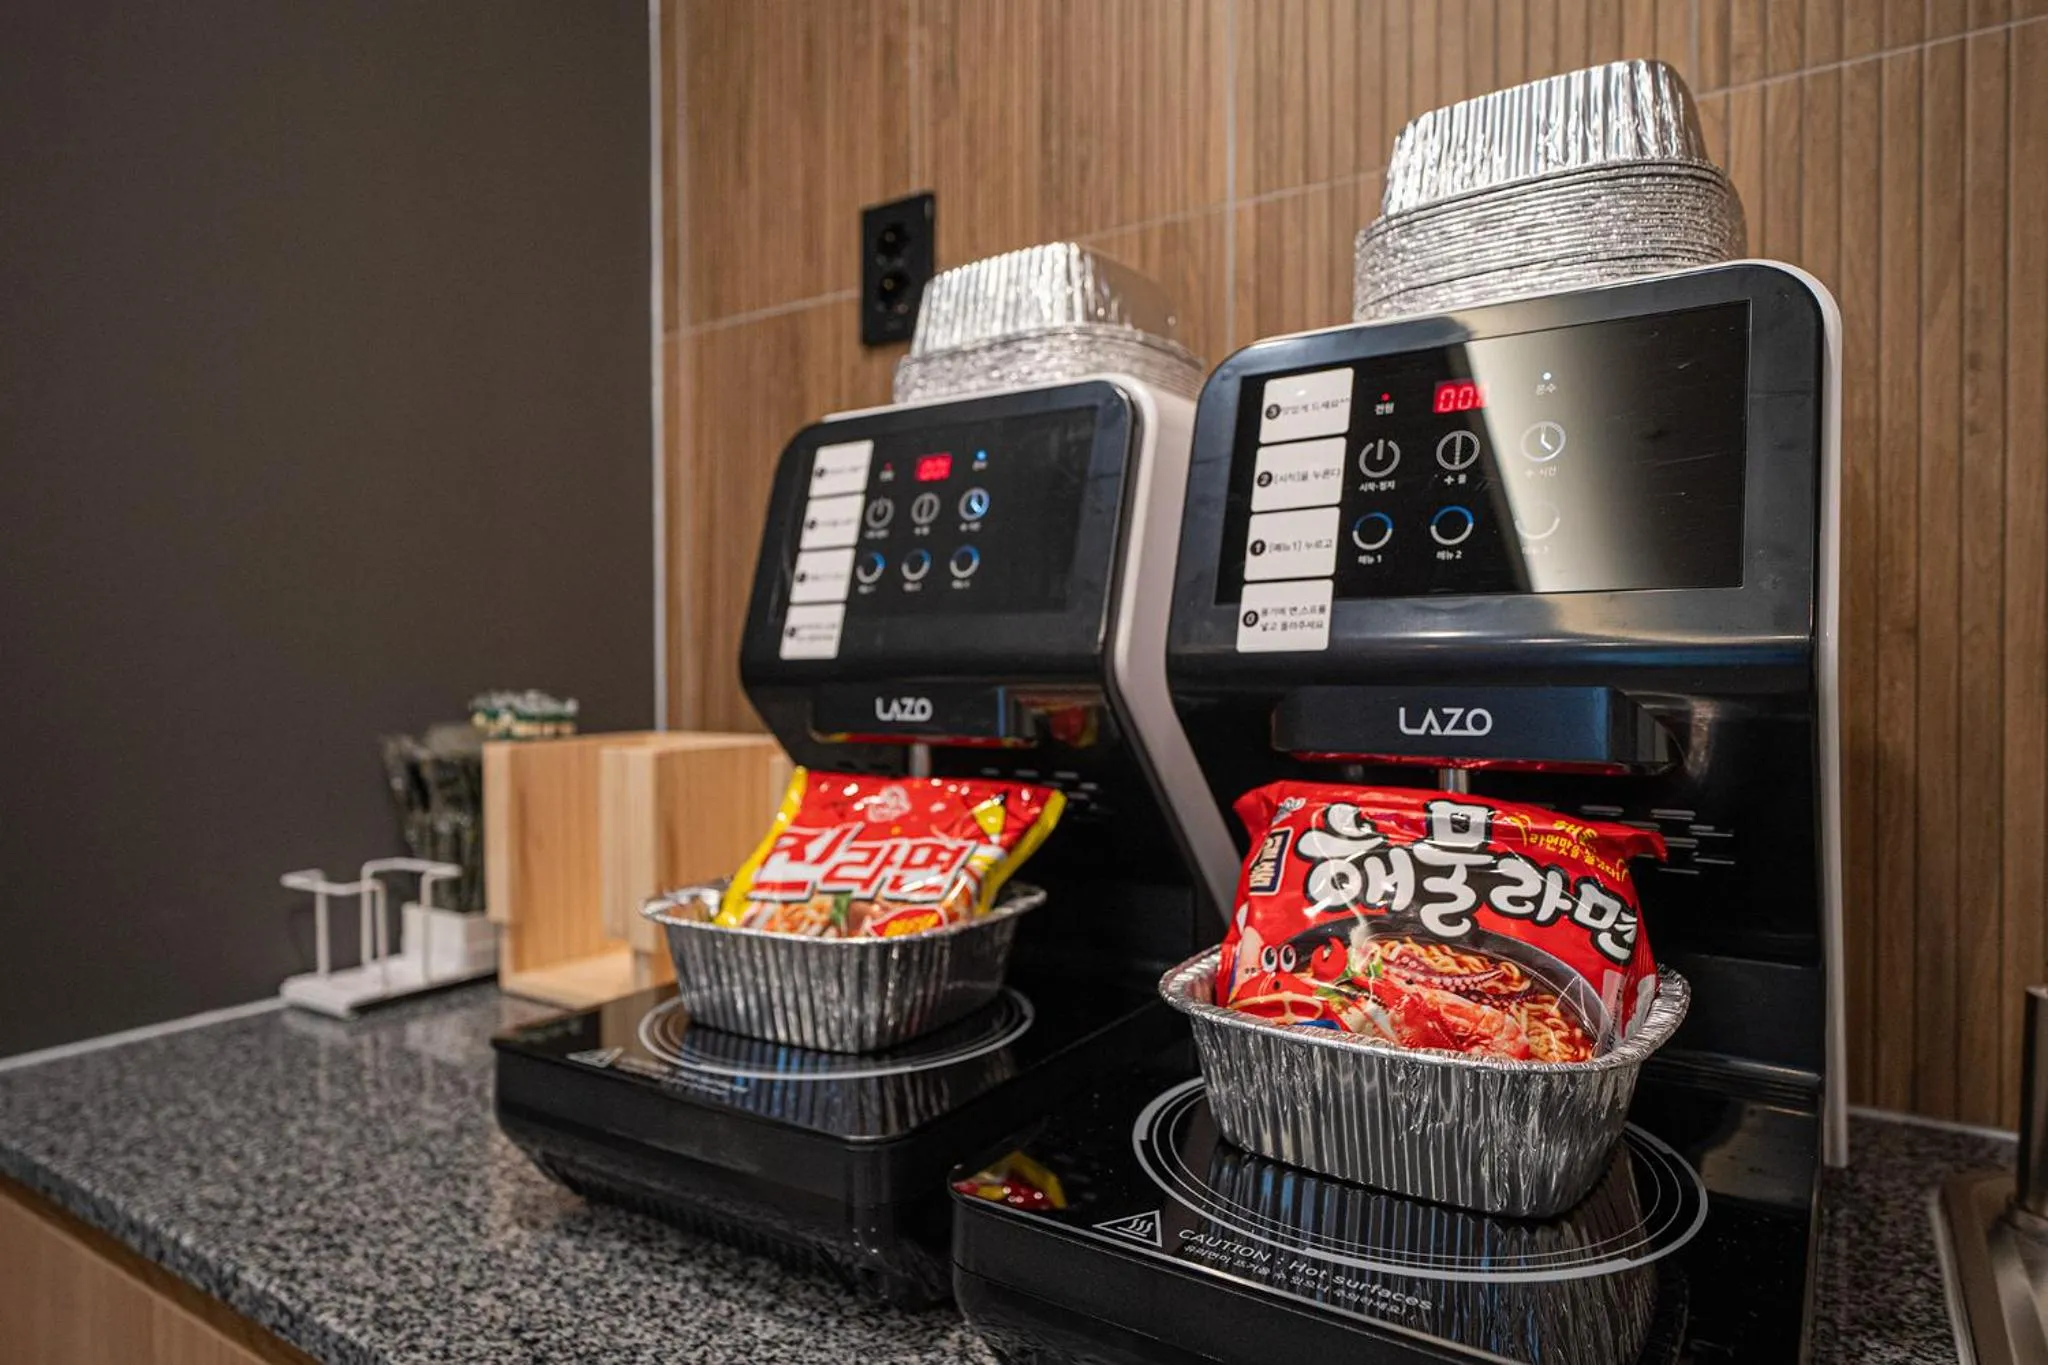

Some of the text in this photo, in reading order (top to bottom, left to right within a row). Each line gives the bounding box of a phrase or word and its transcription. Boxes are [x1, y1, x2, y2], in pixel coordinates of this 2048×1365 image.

[875, 697, 933, 722] LAZO
[1399, 706, 1493, 738] LAZO
[1297, 800, 1638, 960] 해물라면
[1179, 1228, 1272, 1262] CAUTION
[1288, 1260, 1328, 1279] Hot
[1332, 1275, 1433, 1310] surfaces
